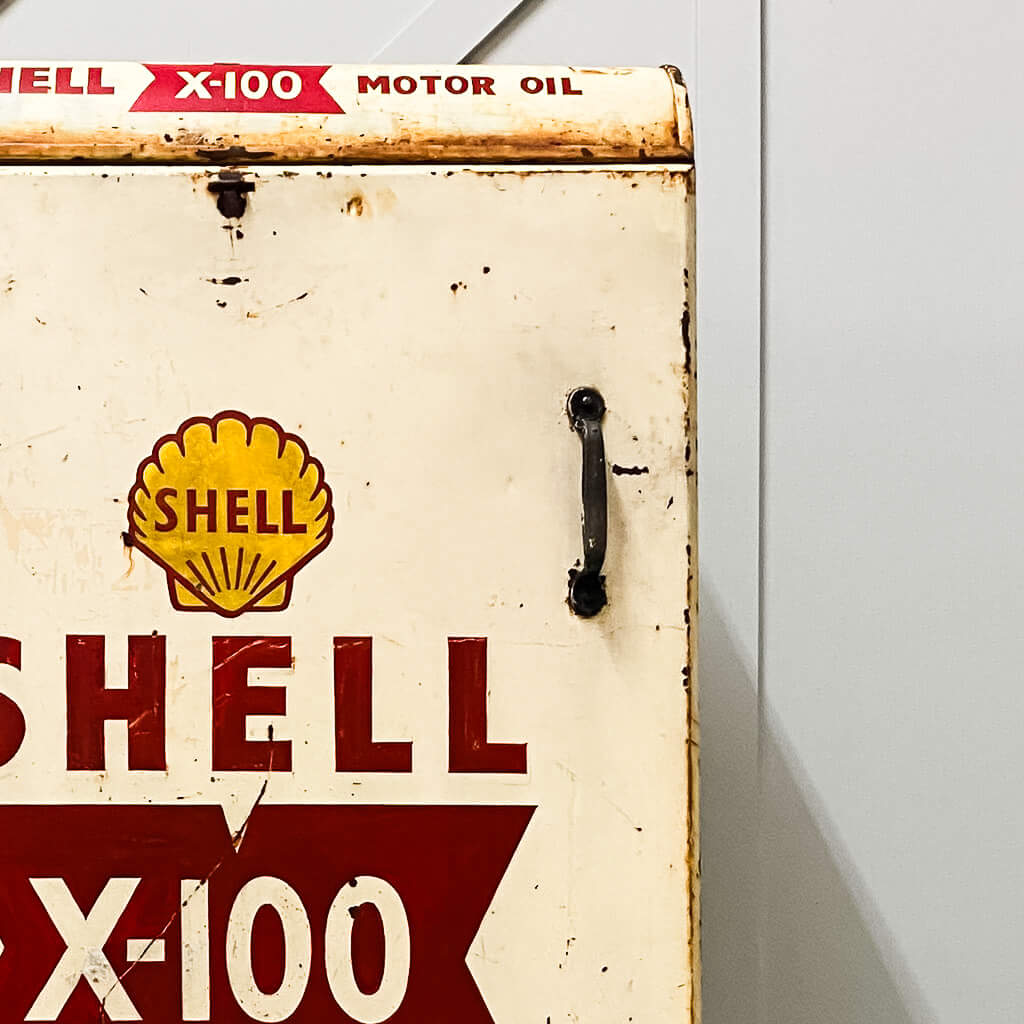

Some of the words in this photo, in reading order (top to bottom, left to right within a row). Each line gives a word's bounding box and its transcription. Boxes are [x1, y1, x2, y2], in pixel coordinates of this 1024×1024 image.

[175, 70, 303, 100] X-100
[357, 75, 495, 96] MOTOR
[520, 77, 583, 96] OIL
[154, 487, 308, 535] SHELL
[23, 875, 411, 1024] X-100
